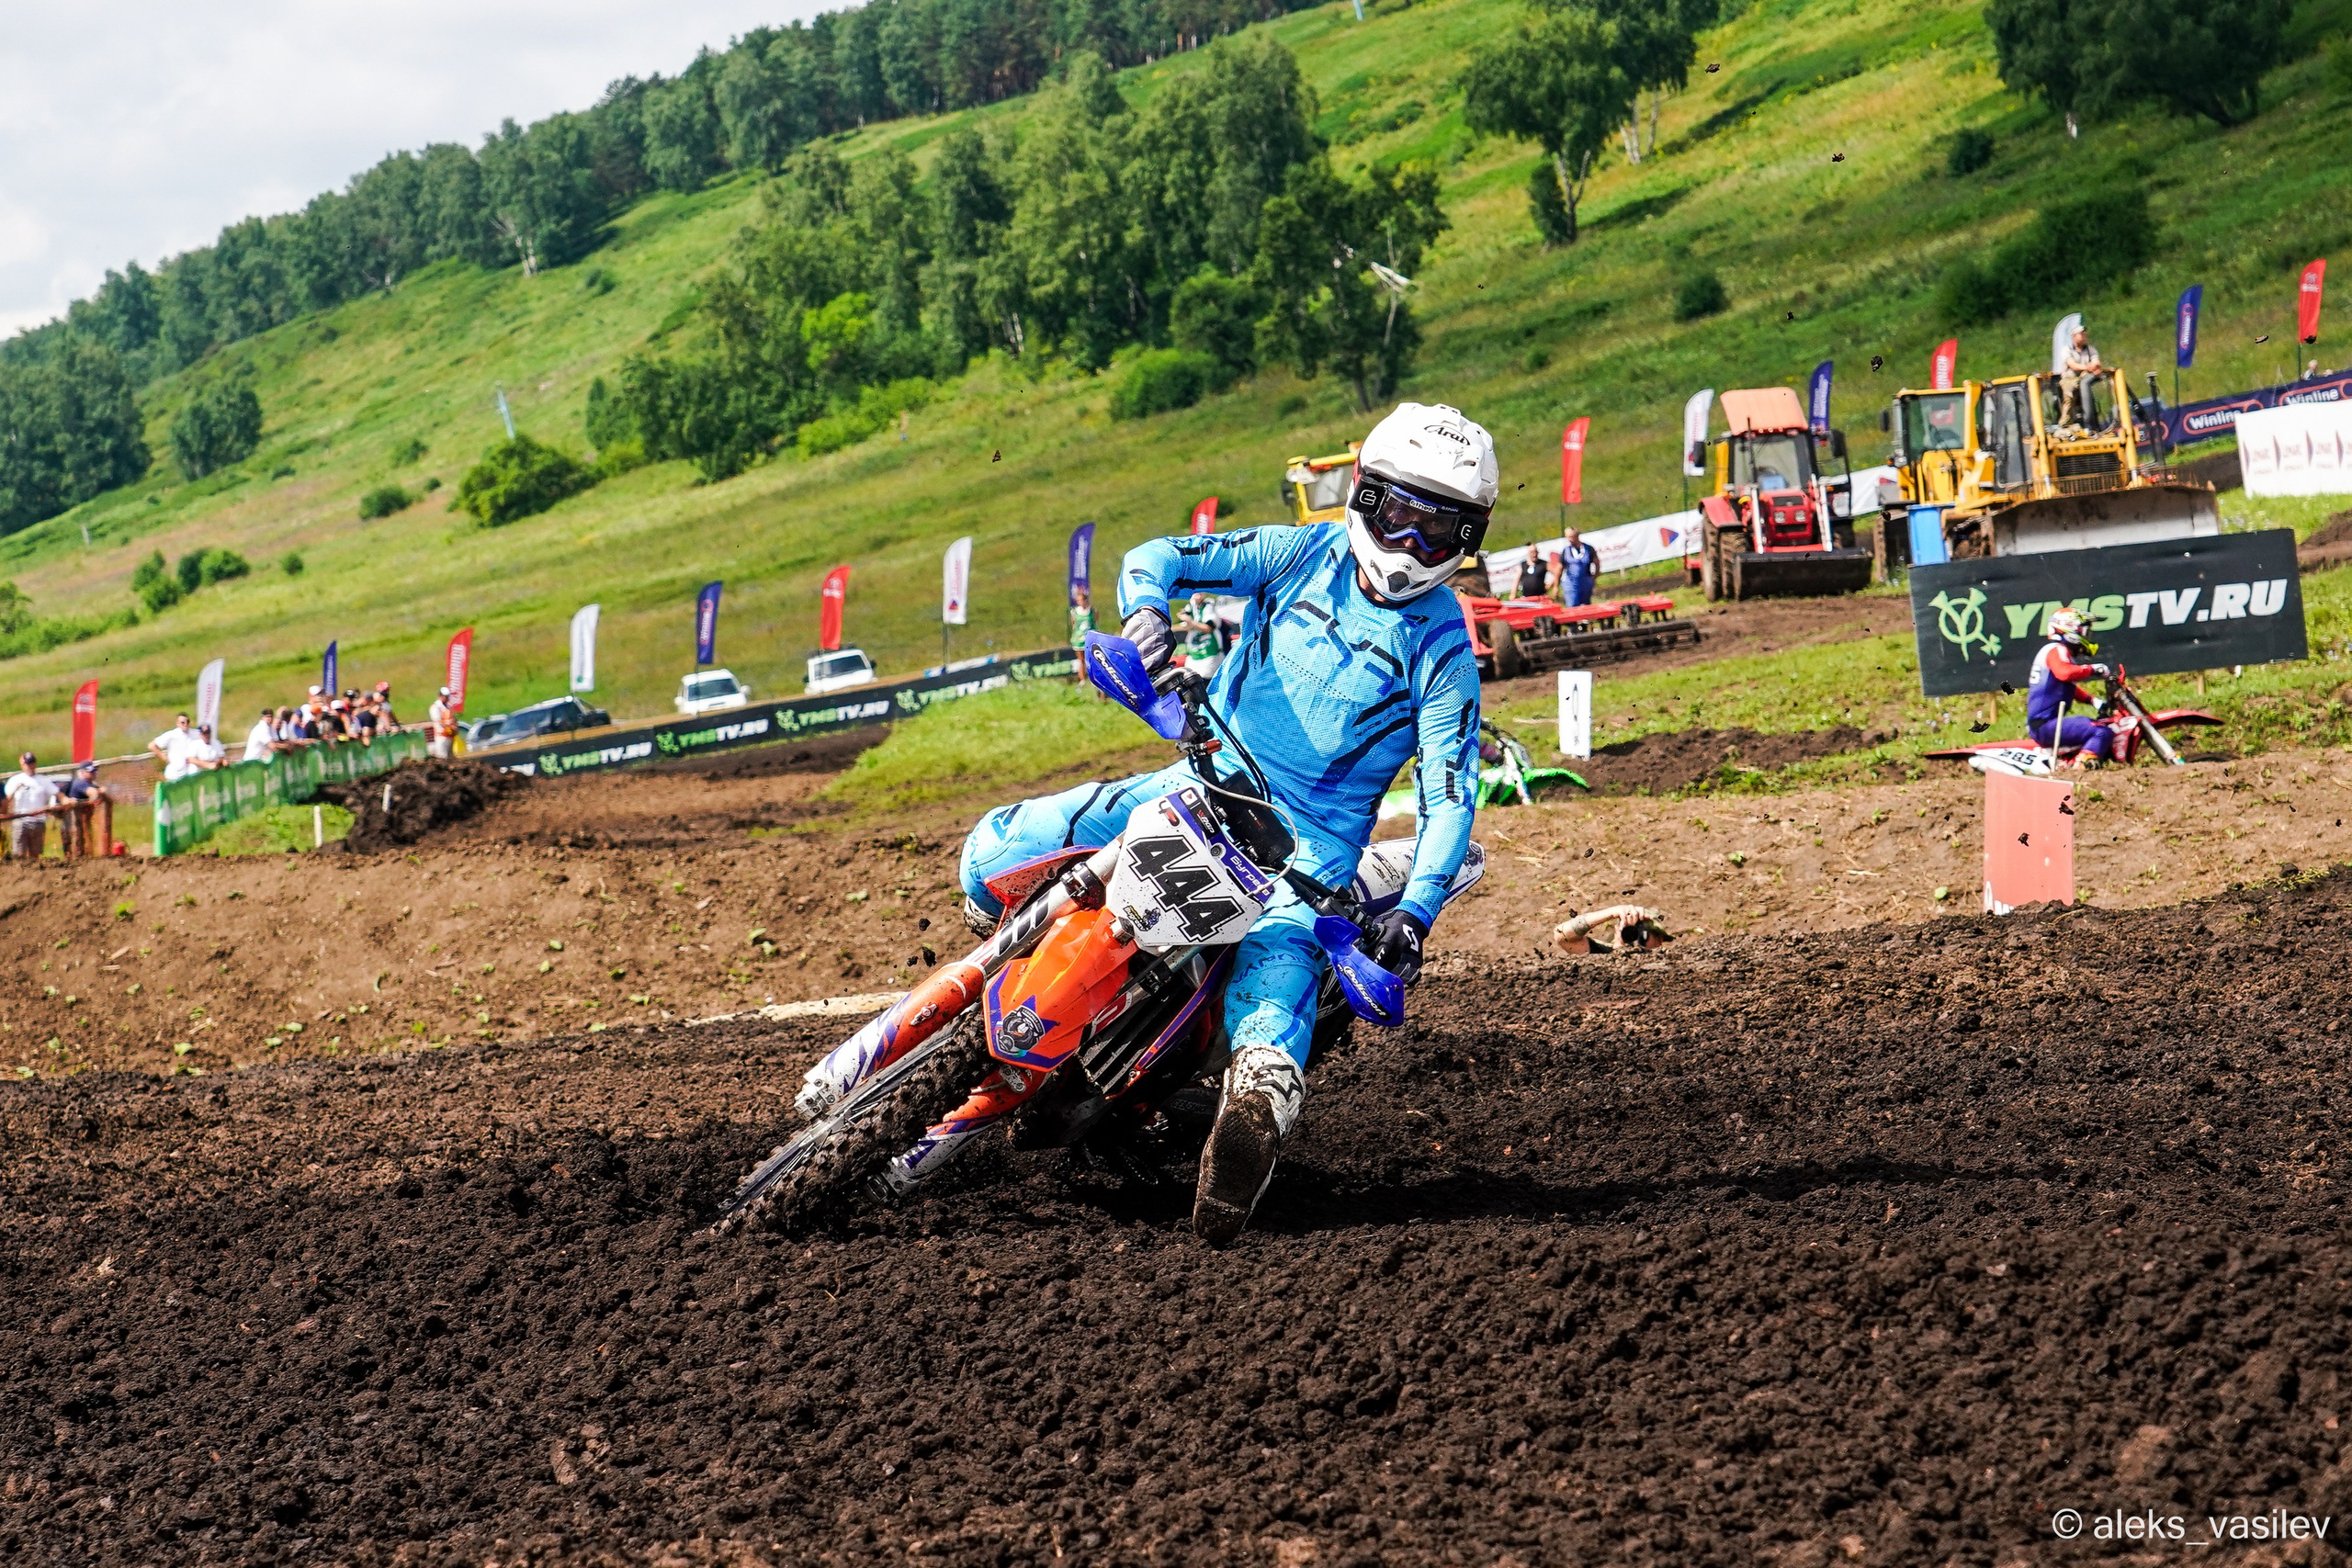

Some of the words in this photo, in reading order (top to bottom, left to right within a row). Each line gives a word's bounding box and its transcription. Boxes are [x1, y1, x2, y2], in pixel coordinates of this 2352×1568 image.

[2003, 579, 2288, 639] YMSTV.RU
[1093, 649, 1138, 699] Polisport
[1126, 835, 1245, 942] 444
[1343, 965, 1386, 1016] Polisport
